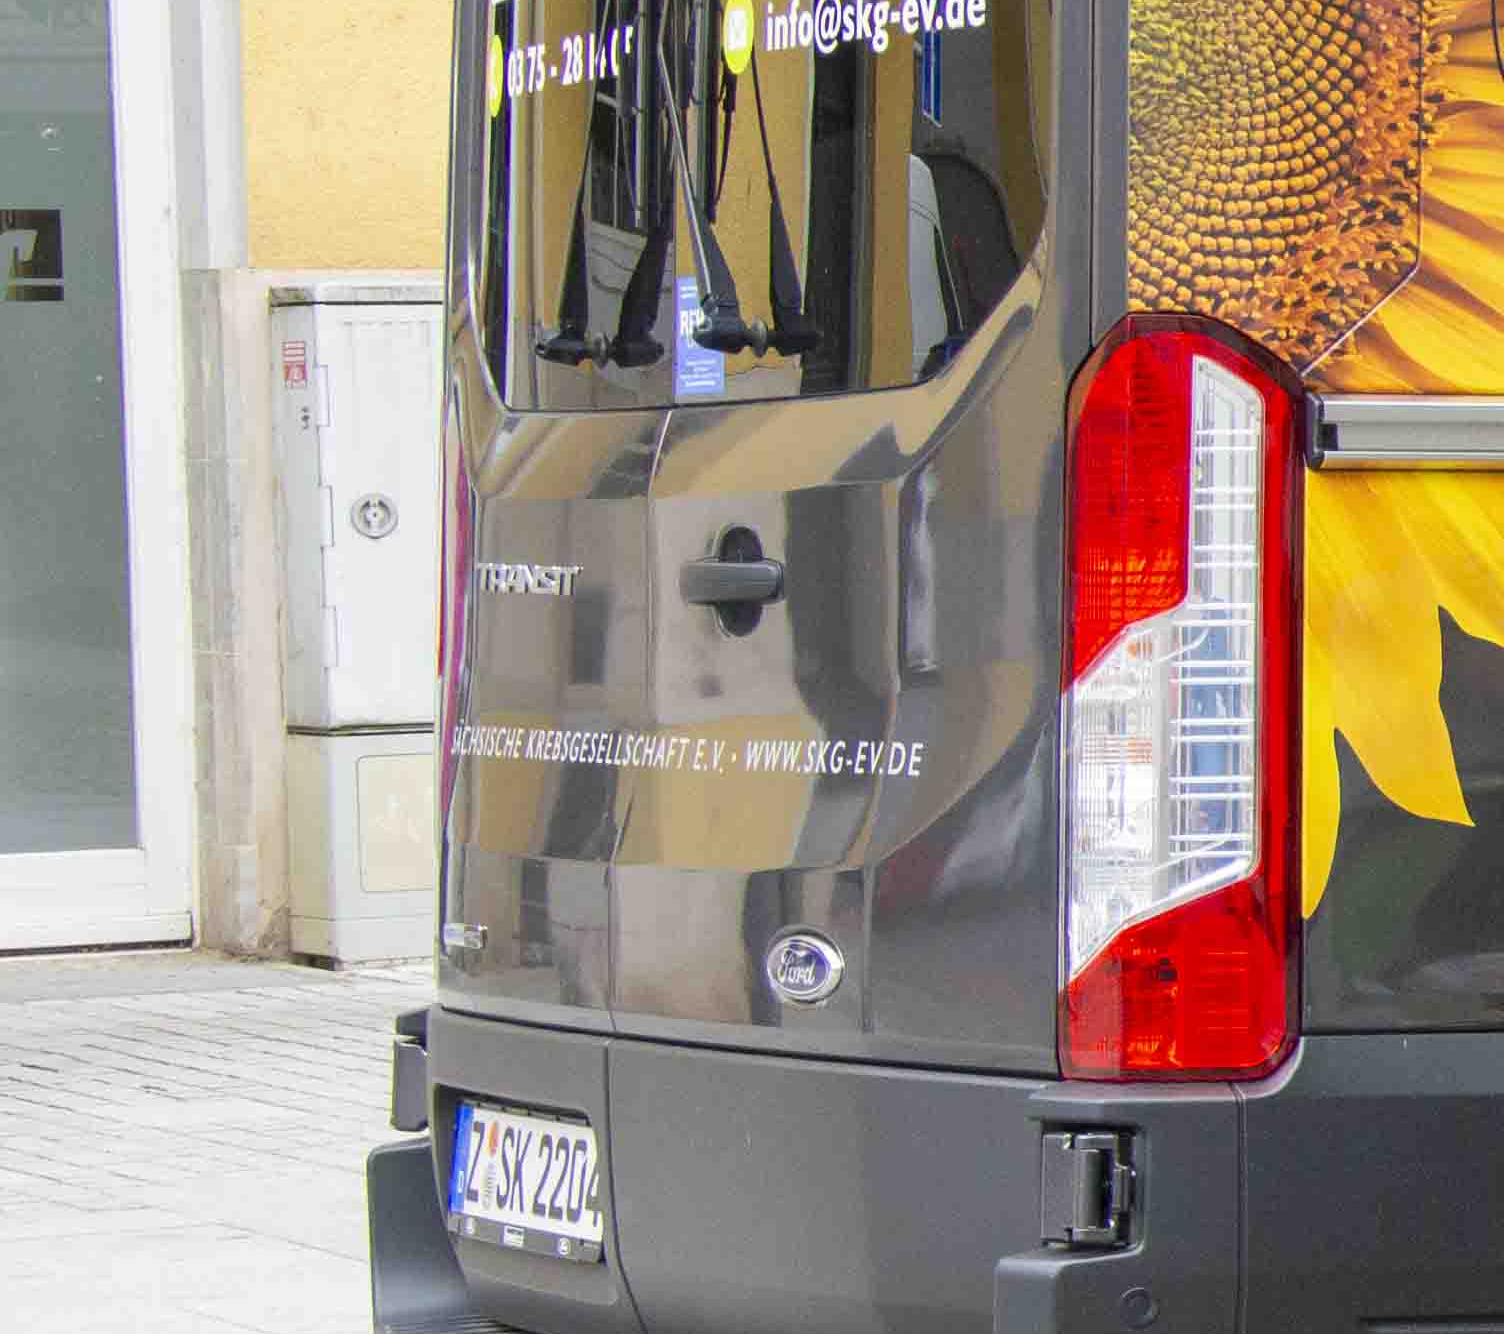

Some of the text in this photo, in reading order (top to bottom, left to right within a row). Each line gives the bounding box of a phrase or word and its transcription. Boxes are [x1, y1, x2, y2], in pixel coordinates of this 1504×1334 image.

[562, 33, 584, 86] 28
[478, 563, 583, 596] TRANSIT
[525, 729, 690, 770] KREBSGESELLSCHAFT
[693, 738, 726, 774] E.V.
[745, 739, 924, 776] WWW.SKG-EV.DE
[466, 1120, 485, 1203] Z
[496, 1125, 533, 1214] SK
